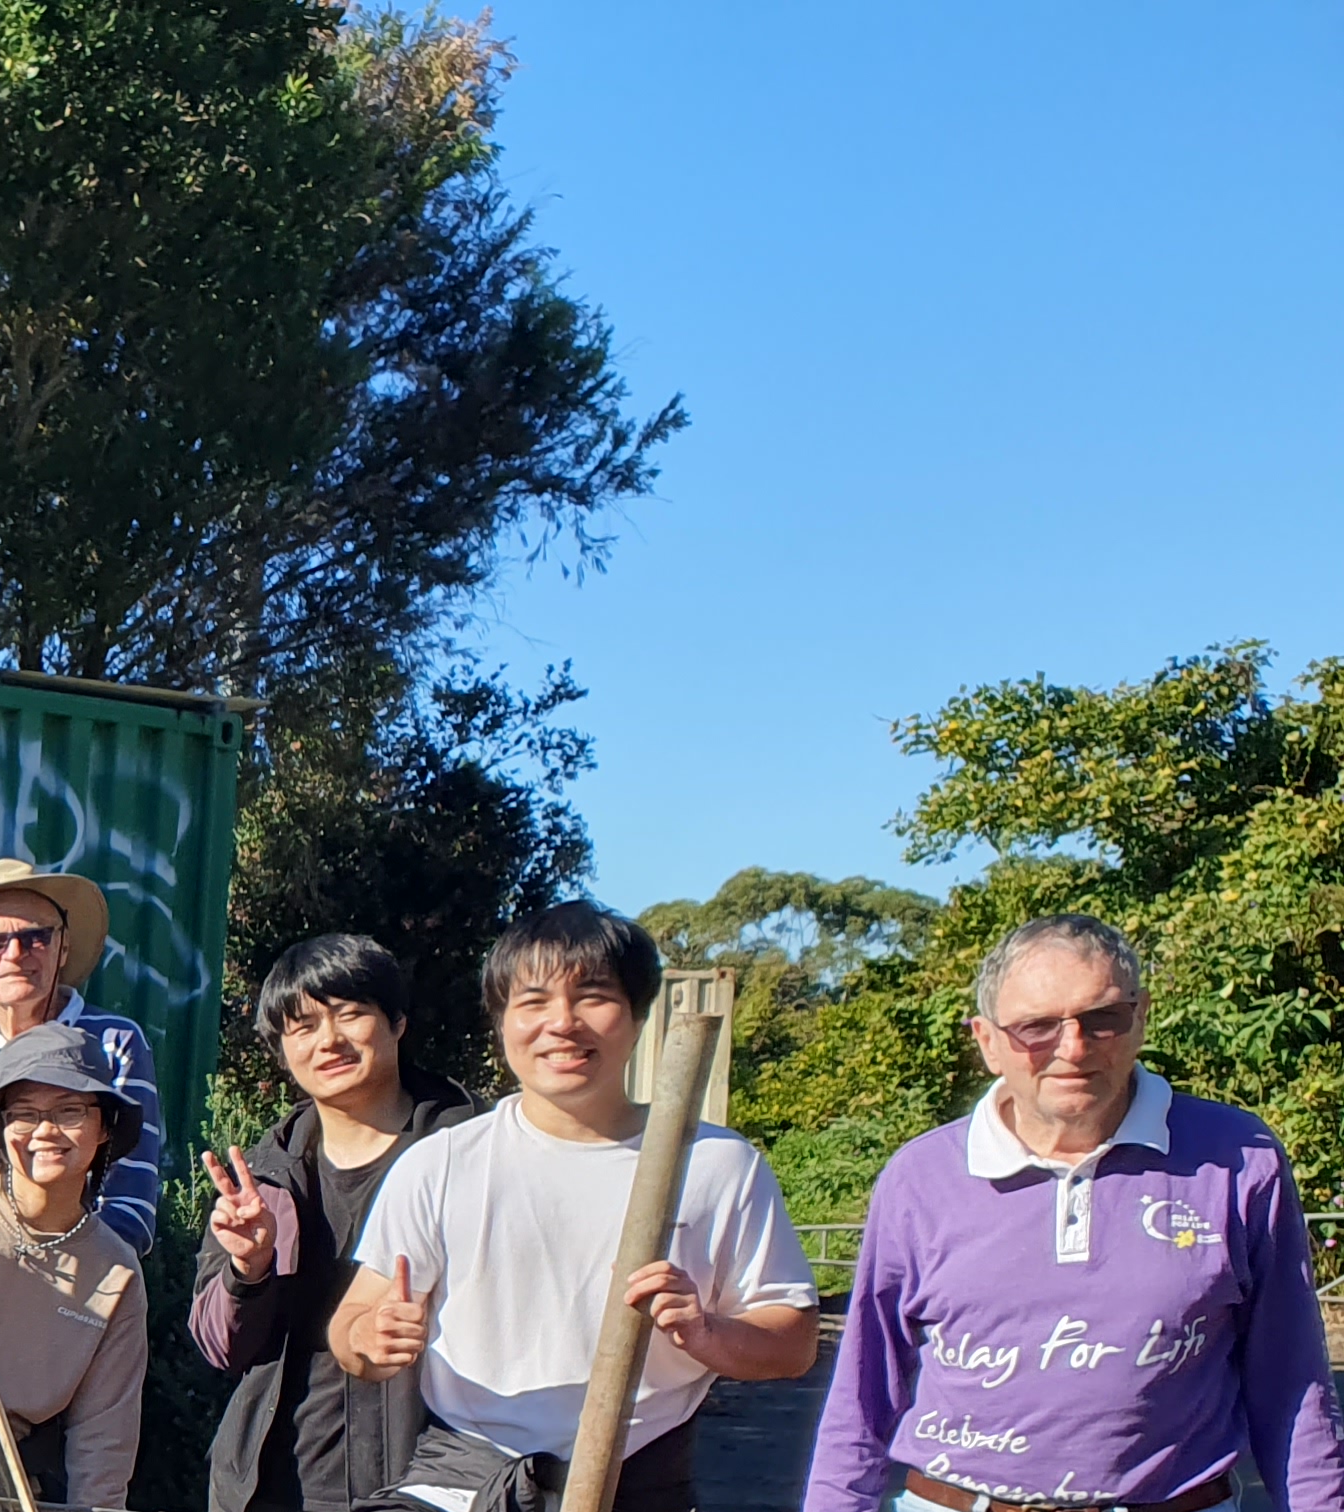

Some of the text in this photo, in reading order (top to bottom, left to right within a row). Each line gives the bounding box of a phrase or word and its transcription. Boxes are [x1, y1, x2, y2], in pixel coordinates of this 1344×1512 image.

[929, 1321, 1019, 1389] Relay
[1039, 1315, 1126, 1370] For
[914, 1410, 1031, 1455] Celebrate
